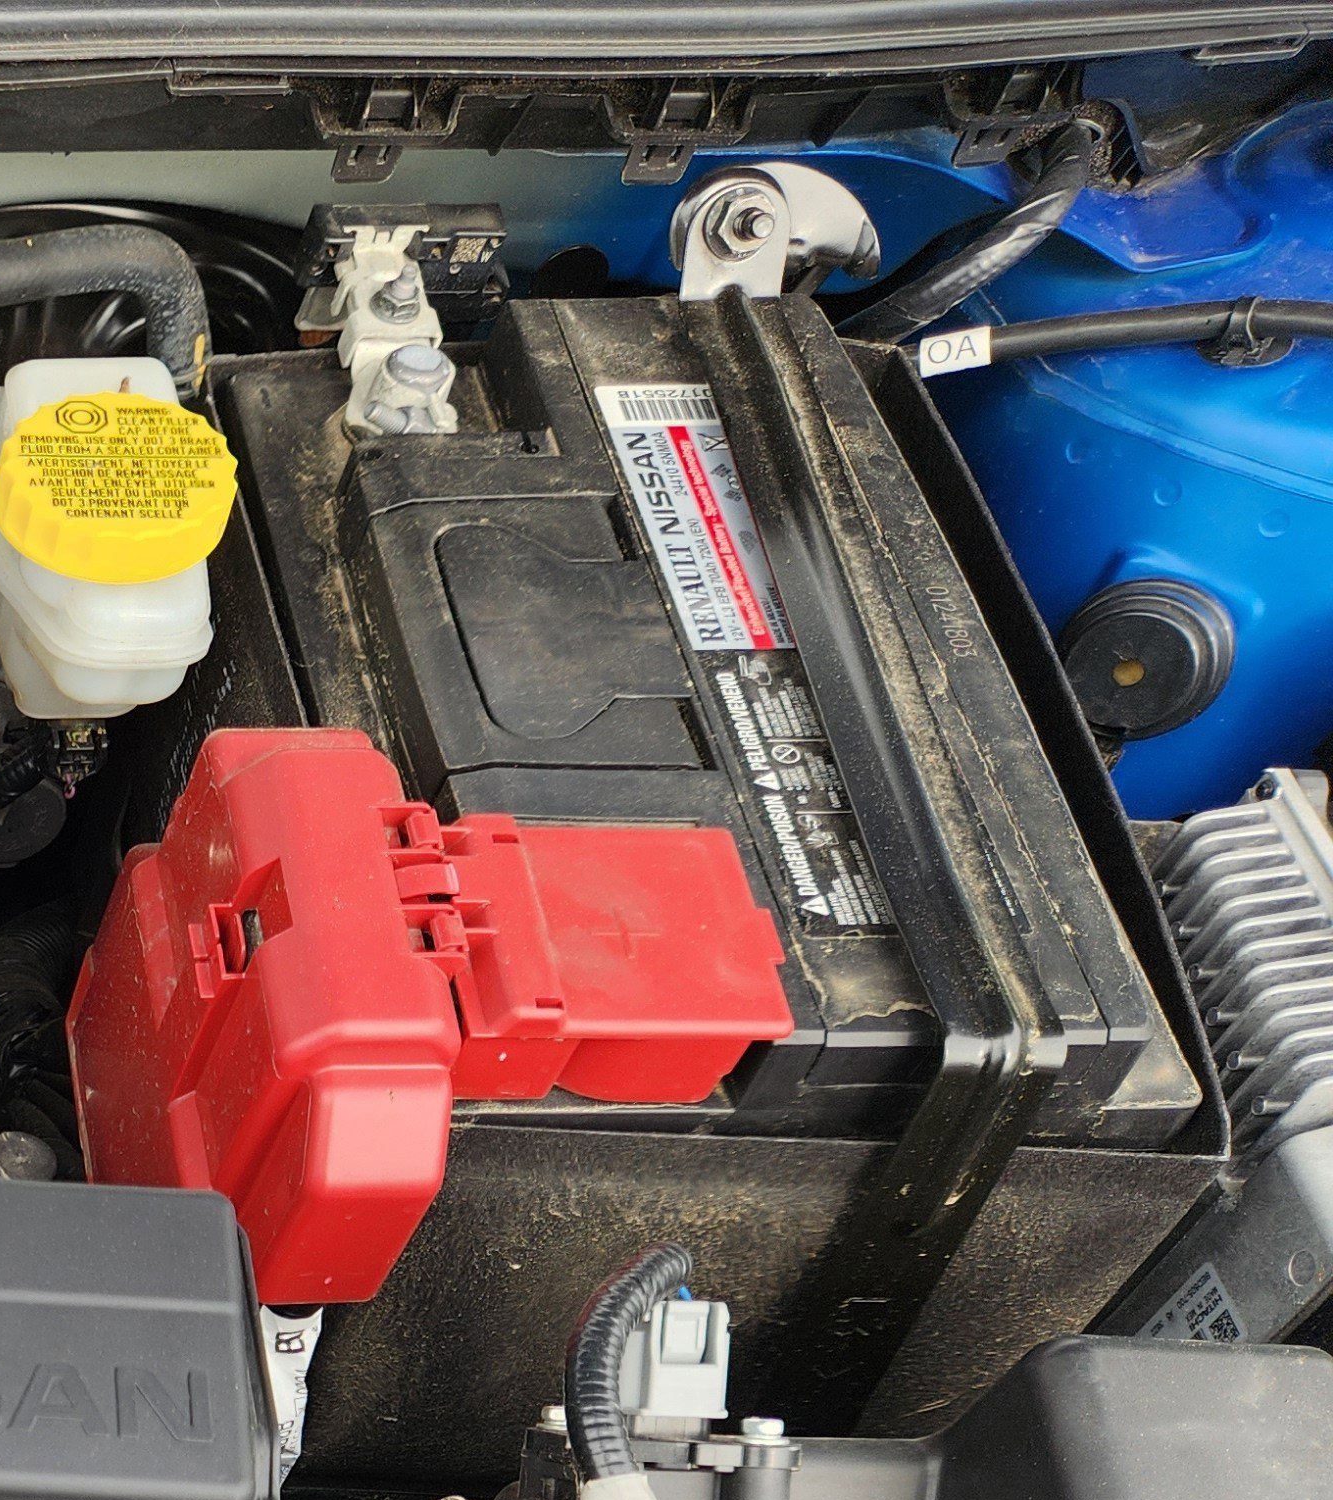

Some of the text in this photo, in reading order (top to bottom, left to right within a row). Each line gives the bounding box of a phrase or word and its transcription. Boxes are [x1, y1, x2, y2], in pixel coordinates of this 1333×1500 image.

[117, 416, 198, 425] CLEAN FILLER
[118, 426, 190, 435] CAP BEFORE
[85, 435, 106, 444] USE
[108, 436, 138, 444] ONLY
[143, 436, 164, 445] DOT
[179, 436, 218, 445] BRAKE
[20, 445, 222, 455] FLUID FROM A SEALED CONTAINER
[131, 459, 192, 468] NETTOYER
[195, 459, 209, 468] LE
[42, 468, 197, 478] BOUCHON DE REMPLISSAGE
[29, 478, 68, 487] AVANT
[73, 478, 87, 487] DE
[163, 479, 215, 488] UTILISER
[51, 488, 187, 497] SEULEMENT DU LIQUIDE
[51, 498, 73, 507] DOT
[87, 498, 158, 507] PROVENANT
[66, 509, 135, 518] CONTENANT
[621, 431, 726, 643] RENAULT NISSAN
[676, 440, 765, 634] Enhanced Flooded Battery Special technology
[715, 670, 770, 771] PELIGRO/VENENO
[762, 793, 817, 895] DANGER/POISON
[1188, 1294, 1223, 1332] HITACHI
